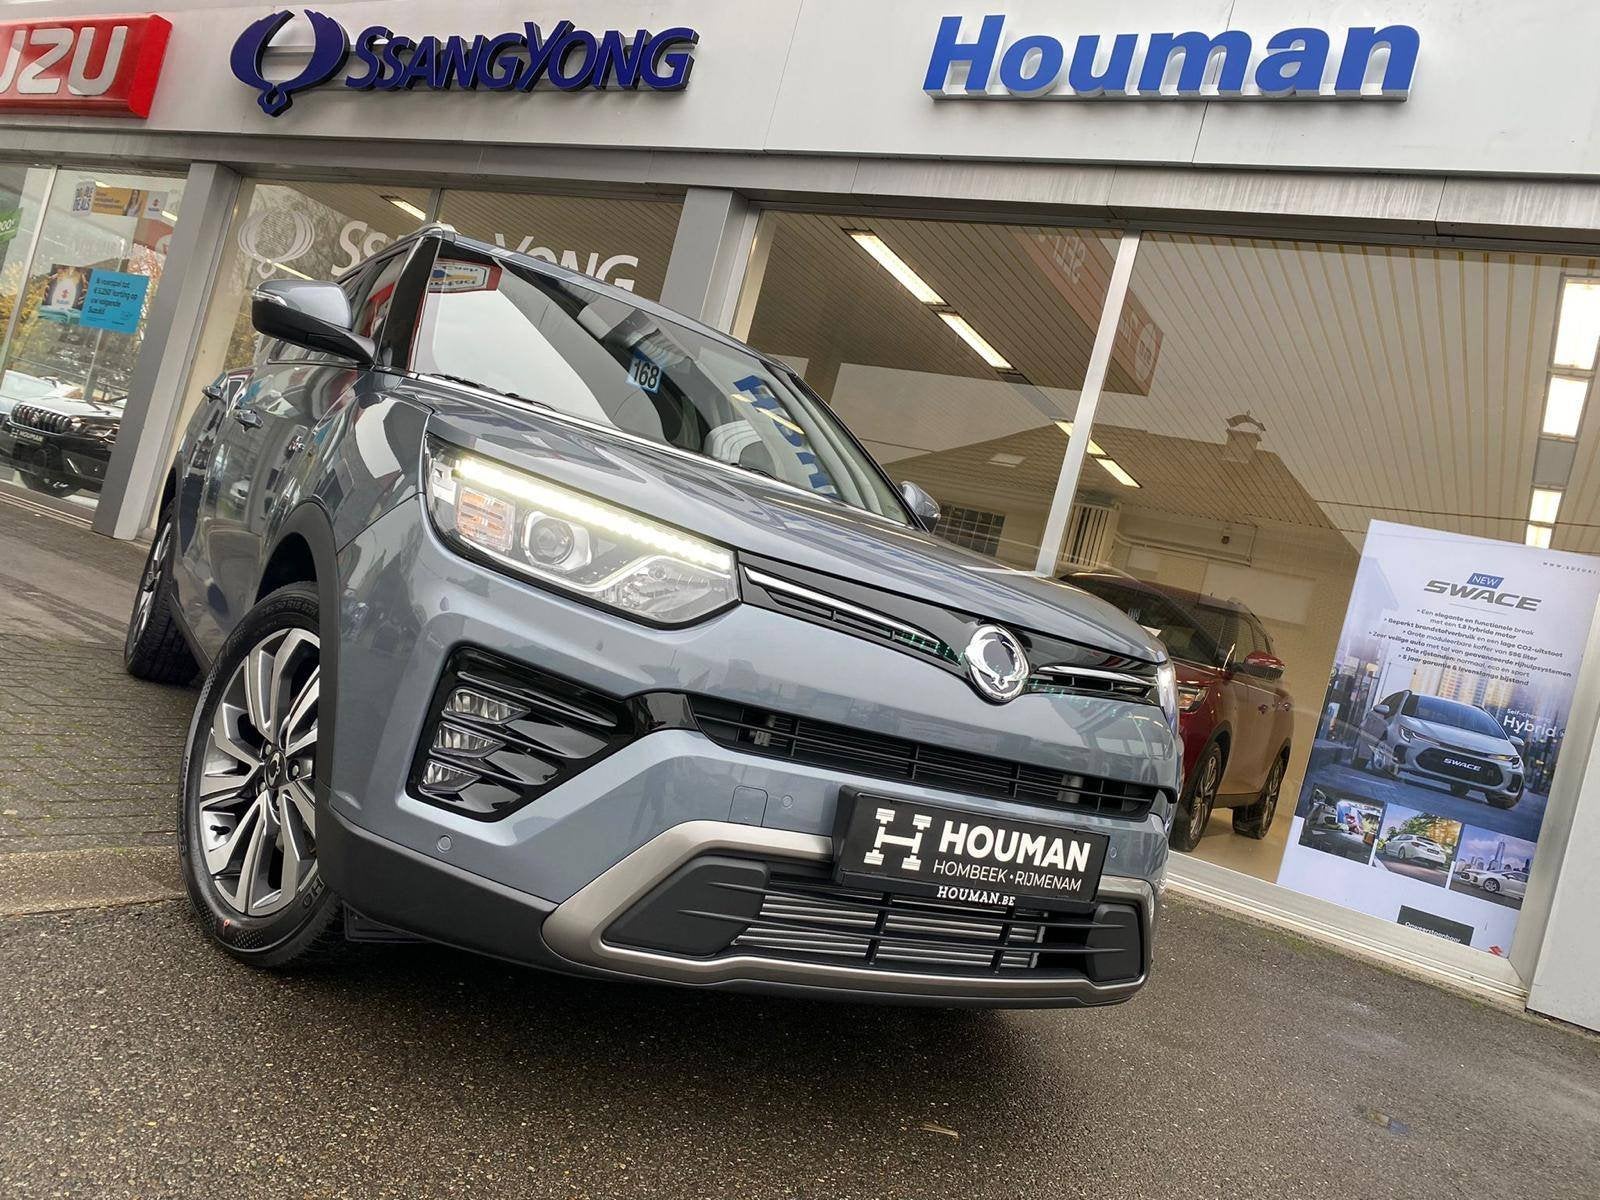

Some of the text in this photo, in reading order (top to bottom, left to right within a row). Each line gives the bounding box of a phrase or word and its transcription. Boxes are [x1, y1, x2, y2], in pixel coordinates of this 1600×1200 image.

[345, 20, 699, 92] SSANGYONG
[922, 14, 1420, 98] Houman
[634, 359, 660, 389] 168
[1472, 575, 1499, 586] NEW
[1424, 580, 1542, 612] SWACE
[1415, 623, 1475, 640] brandstofverbruik
[1500, 640, 1516, 649] lage
[1434, 612, 1463, 621] elegante
[1475, 619, 1513, 632] functionele
[1514, 626, 1534, 636] break
[1468, 625, 1494, 635] hybride
[1372, 631, 1386, 639] Zeer
[1388, 634, 1409, 643] veilige
[1464, 651, 1514, 666] geavanceerde
[1473, 643, 1493, 652] koffer
[1407, 655, 1421, 663] jaar
[1422, 659, 1451, 669] garantie
[1500, 674, 1530, 686] bijstand
[1511, 669, 1530, 678] sport
[1503, 715, 1557, 738] Hybrid
[1443, 758, 1481, 772] SWACE
[938, 820, 1091, 872] HOUMAN
[933, 859, 1082, 892] HOMBEEK RIJMENAM
[937, 885, 1016, 907] HOUMAN.BE
